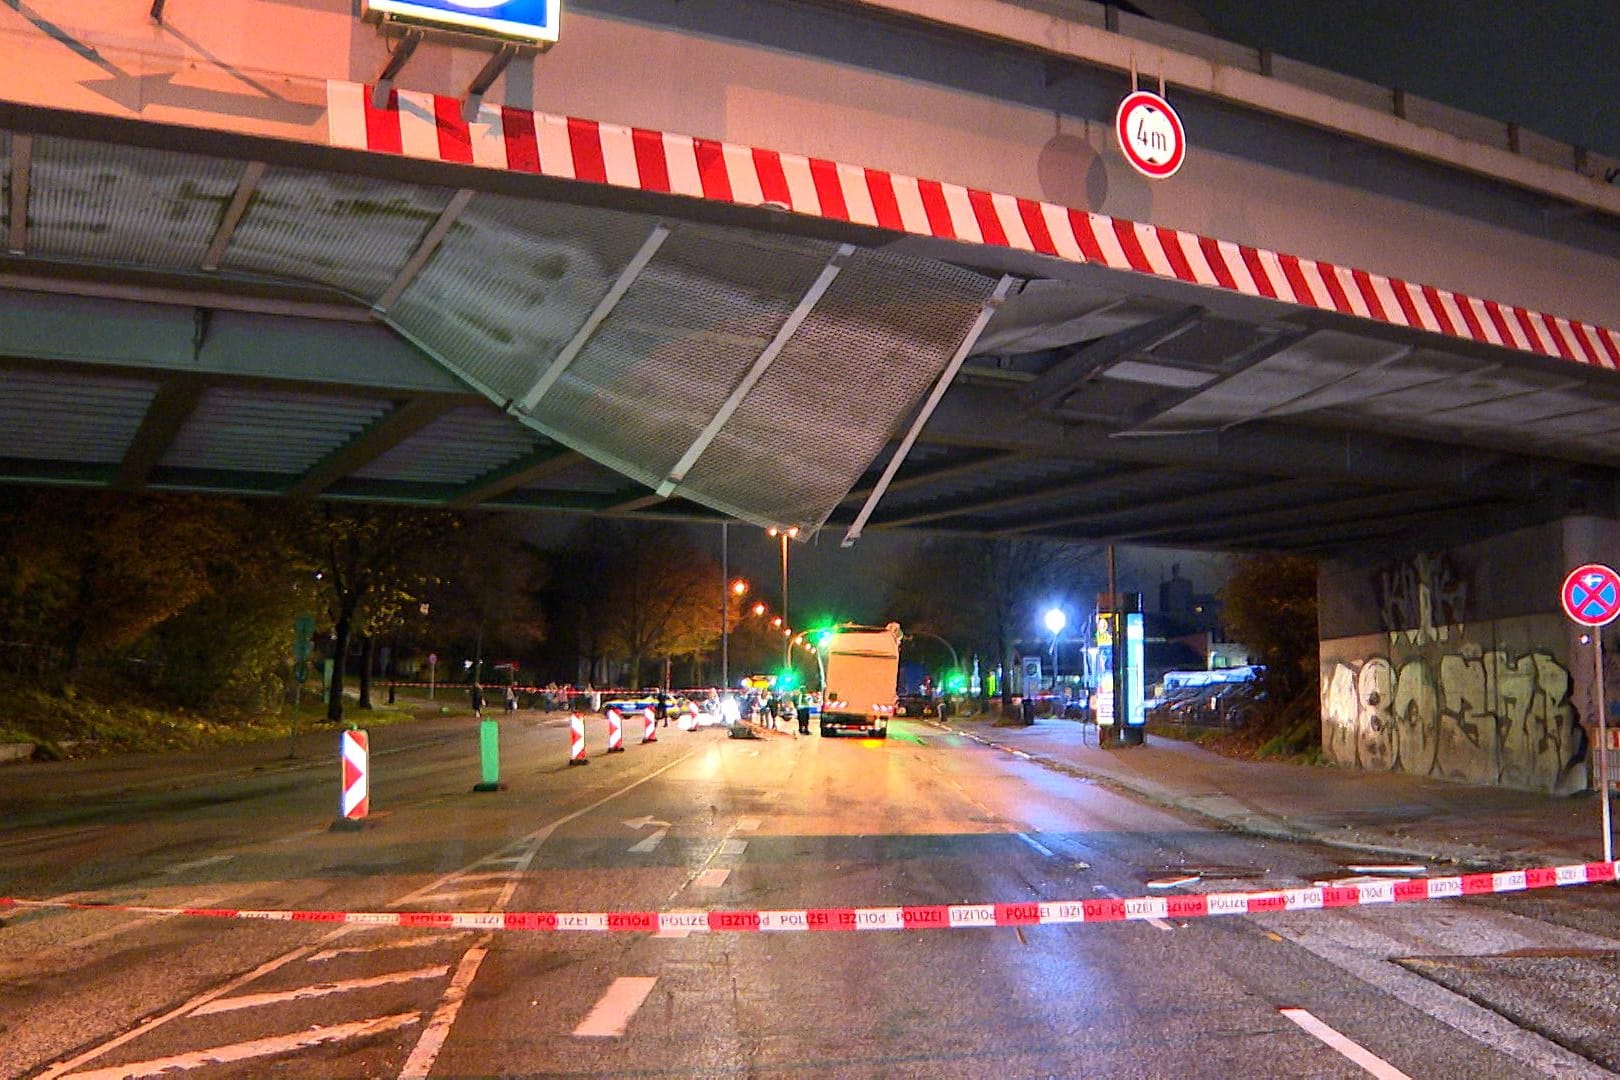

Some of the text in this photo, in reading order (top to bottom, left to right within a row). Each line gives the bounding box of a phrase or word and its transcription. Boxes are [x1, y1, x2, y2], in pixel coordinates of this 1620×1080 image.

[1136, 117, 1167, 152] 4m
[536, 915, 588, 926] POLIZEI
[600, 915, 651, 926] POLIZEI
[661, 915, 710, 926] POLIZEI
[721, 915, 770, 926] POLIZEI
[781, 912, 829, 925] POLIZEI
[839, 912, 886, 924] POLIZEI
[896, 910, 942, 923] POLIZEI
[952, 909, 997, 922] POLIZEI
[1006, 906, 1050, 920] POLIZEI
[1111, 902, 1153, 915] POLIZEI
[1210, 898, 1247, 910] POLIZE
[1303, 891, 1340, 904] POLZEI
[1430, 880, 1464, 893] OLIZEI
